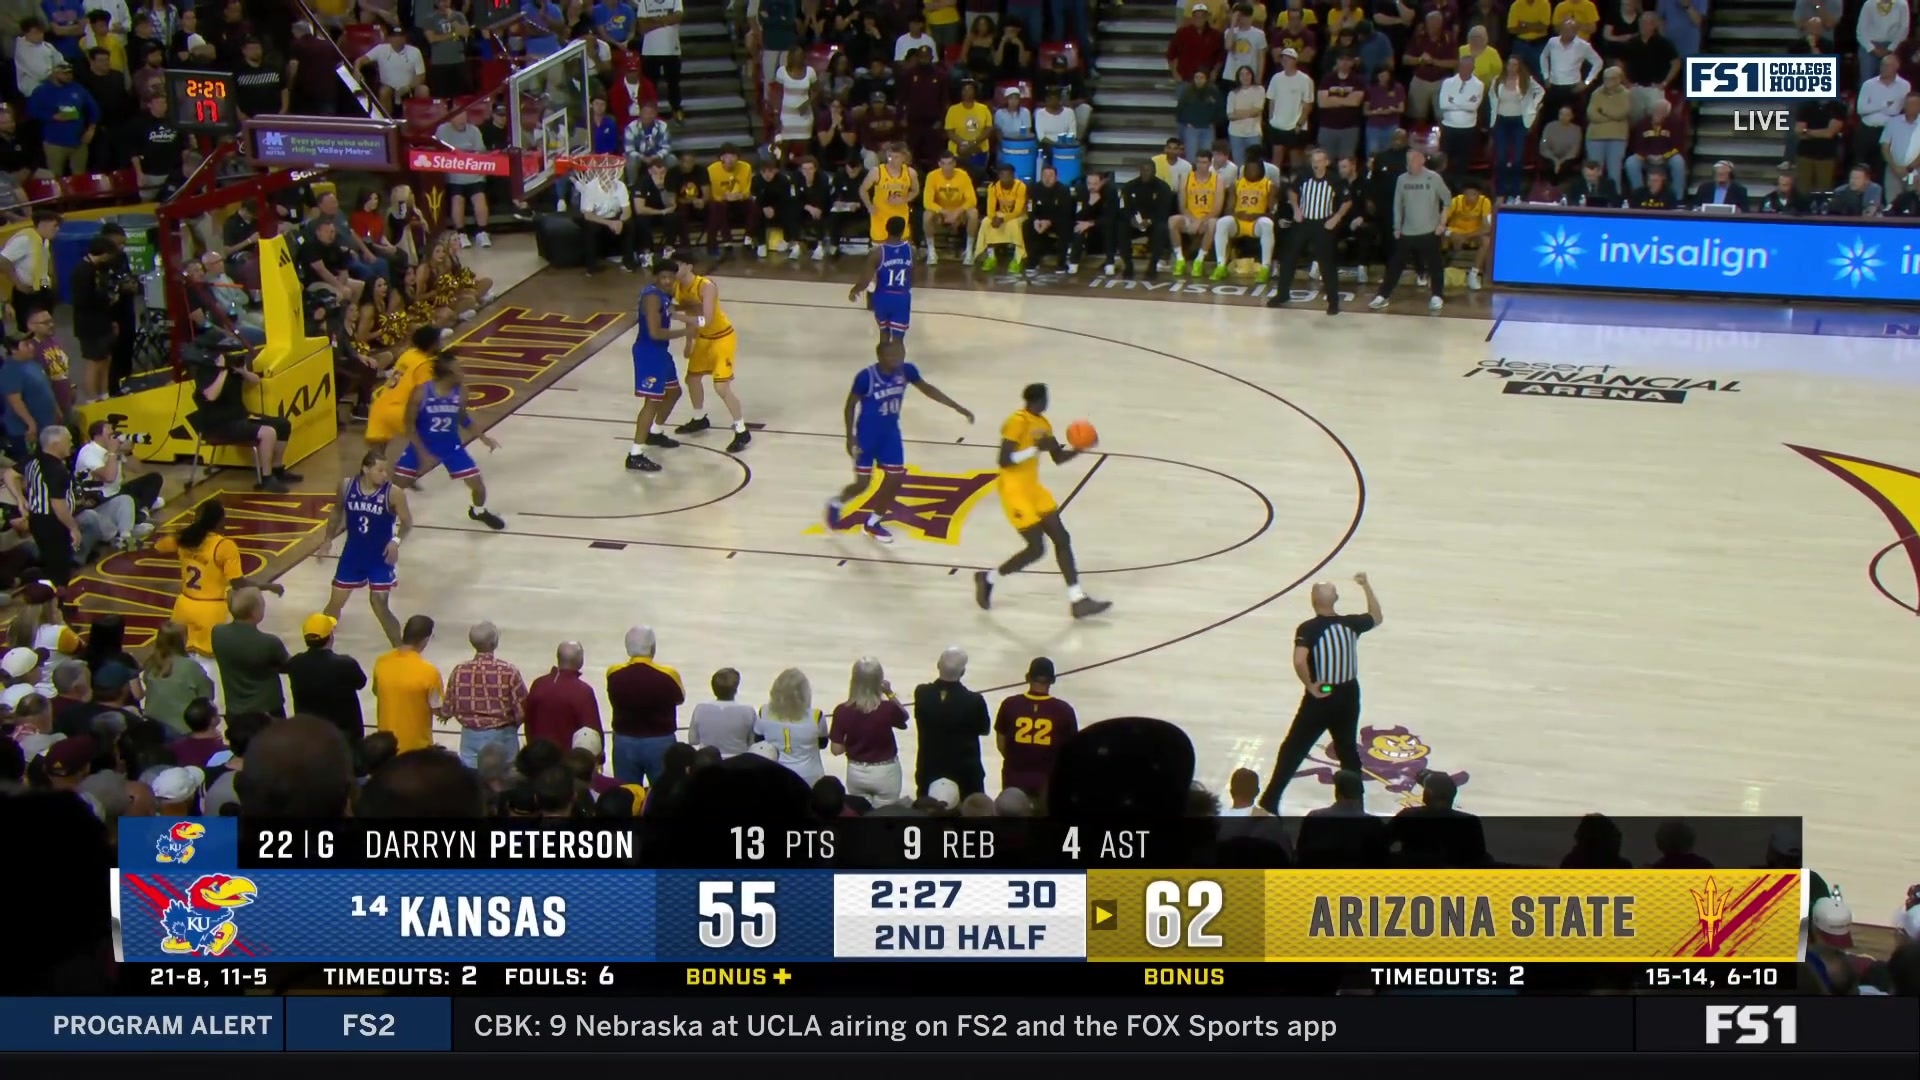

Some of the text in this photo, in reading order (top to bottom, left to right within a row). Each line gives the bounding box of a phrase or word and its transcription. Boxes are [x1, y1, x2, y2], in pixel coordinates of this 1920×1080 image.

[196, 100, 218, 123] 17
[1599, 233, 1768, 276] invisalign
[886, 268, 907, 287] 14
[1477, 357, 1617, 374] desert
[1520, 383, 1668, 401] ARENA
[878, 398, 900, 416] 40
[429, 416, 453, 433] 22
[347, 500, 384, 516] KANSAS
[358, 515, 370, 534] 3
[186, 564, 202, 591] 2
[1014, 716, 1053, 746] 22
[783, 727, 792, 755] 1
